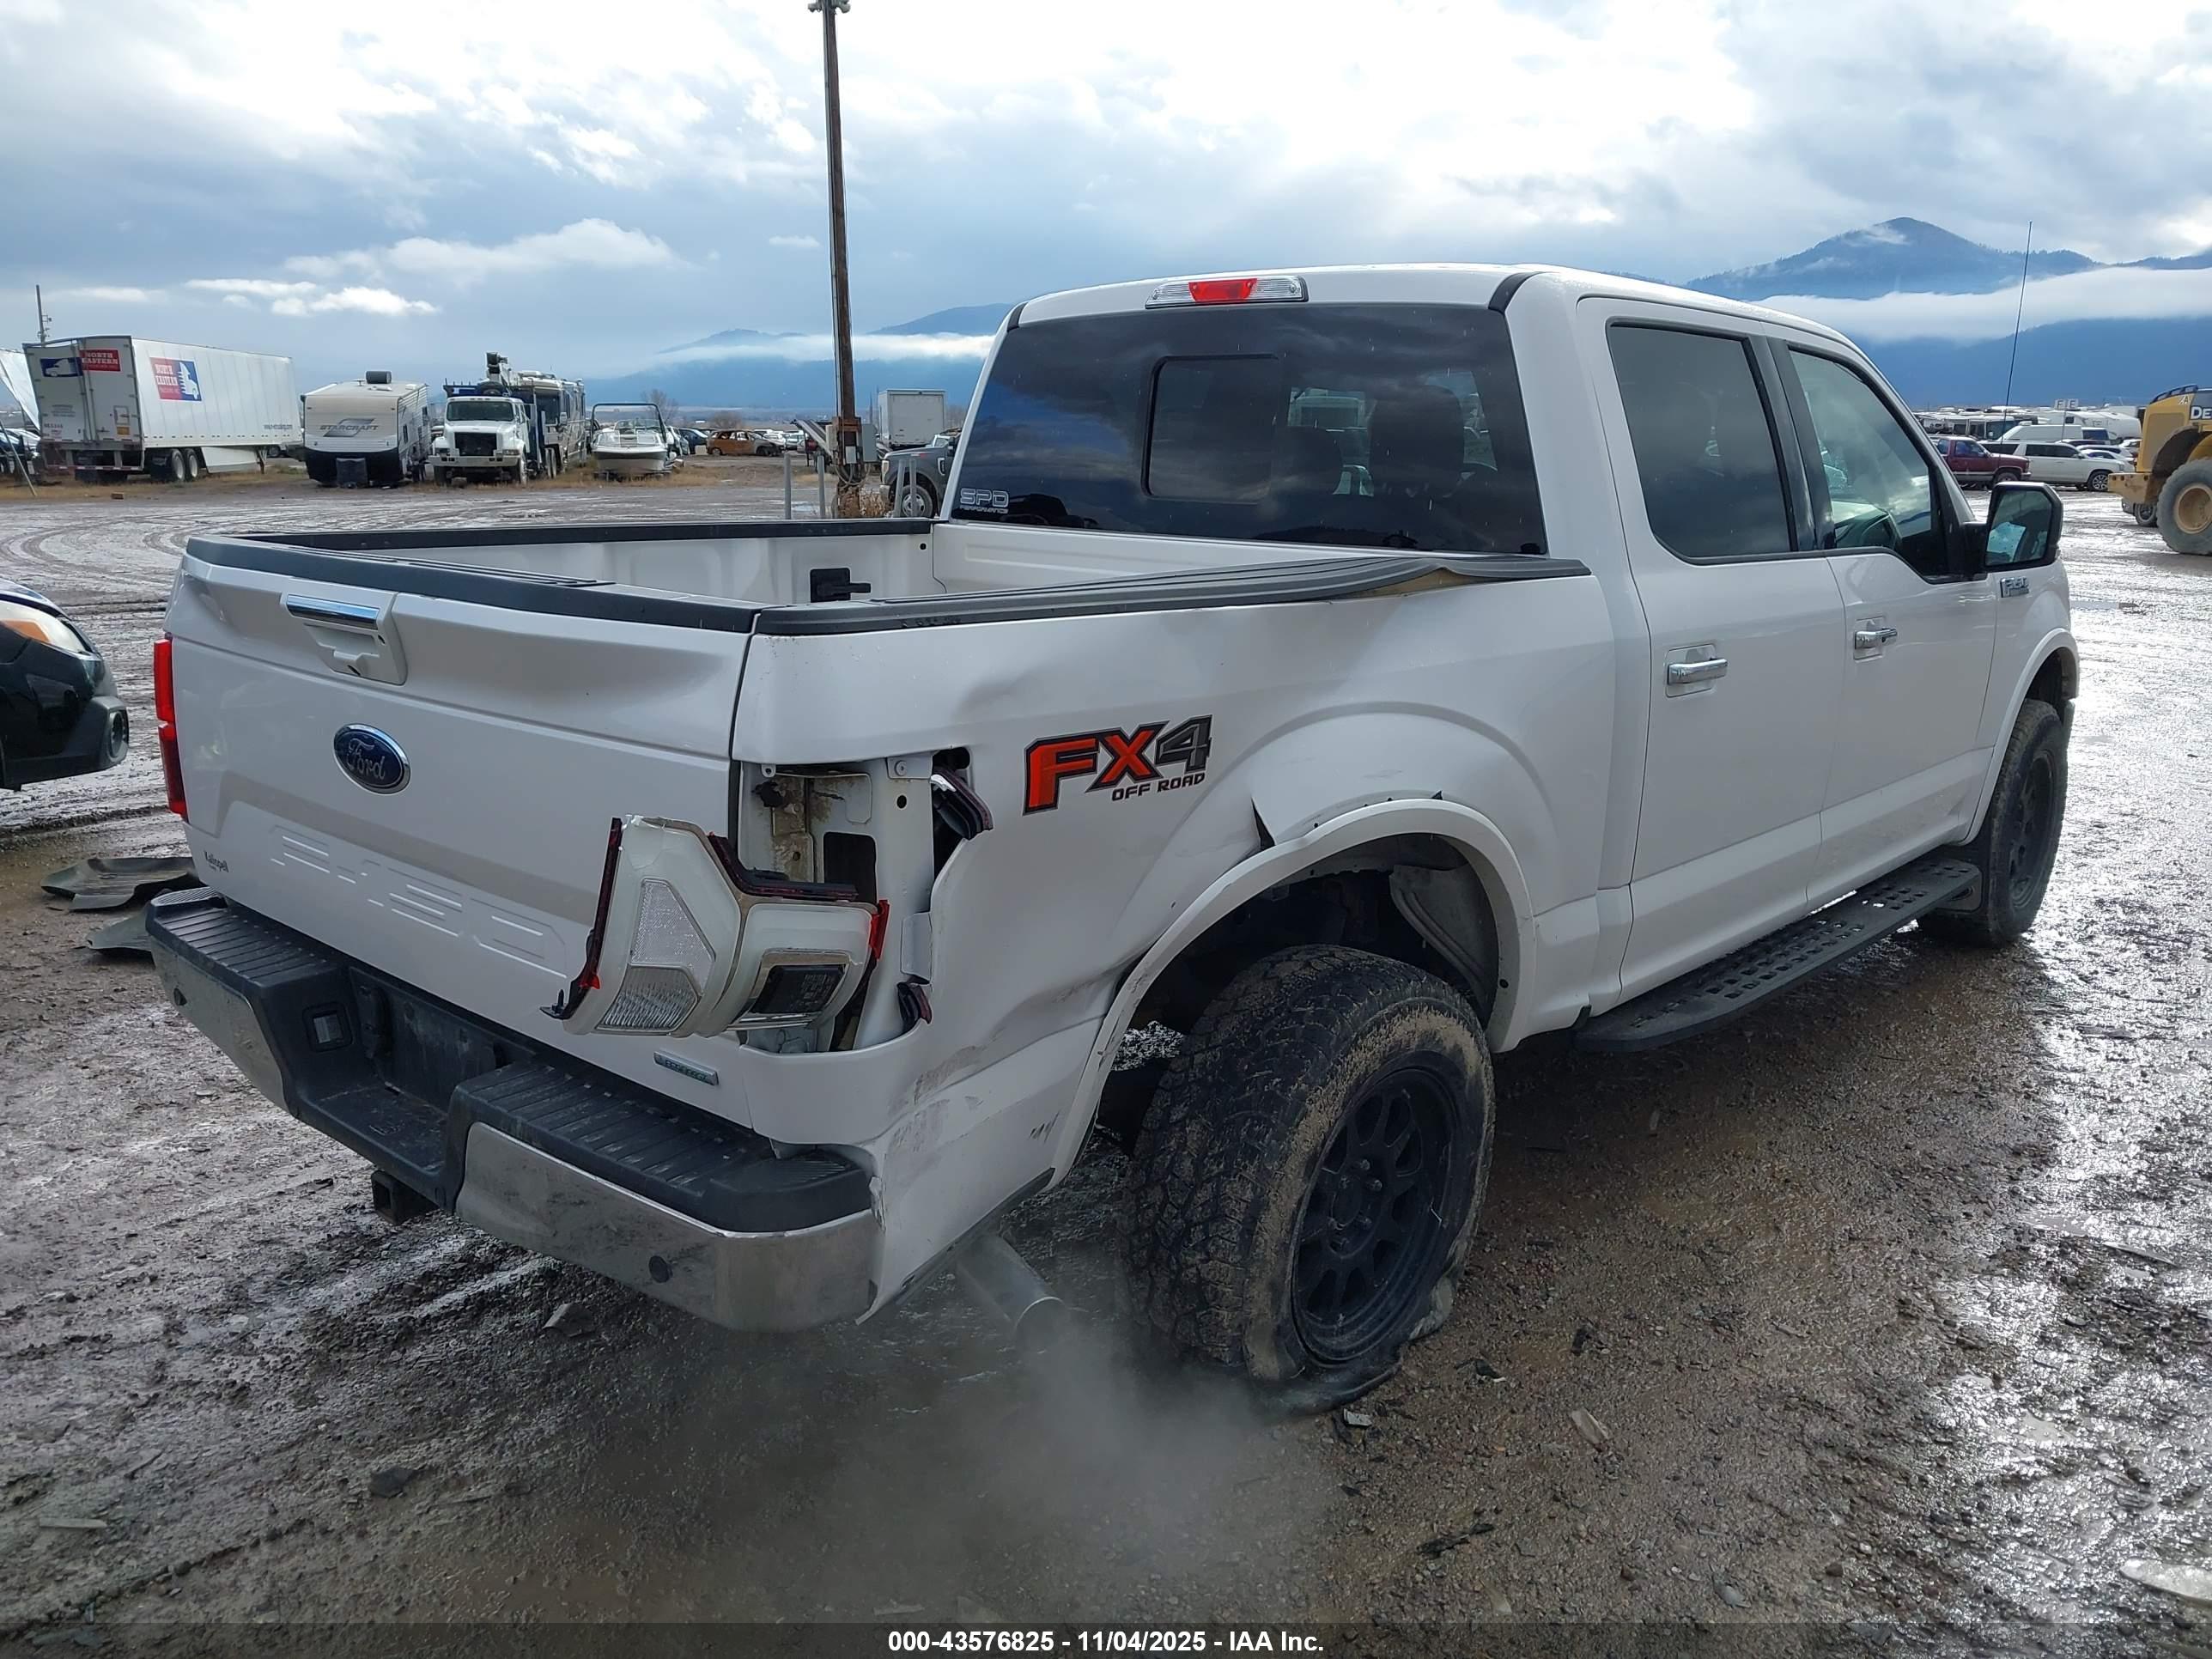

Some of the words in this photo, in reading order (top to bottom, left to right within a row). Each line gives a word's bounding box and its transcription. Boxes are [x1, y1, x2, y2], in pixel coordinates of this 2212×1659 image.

[155, 364, 173, 374] NORTH
[155, 375, 179, 386] EASTERN
[960, 488, 1009, 507] SPD
[346, 738, 386, 780] Ford
[1022, 714, 1212, 816] FX4
[1111, 782, 1151, 802] OFF
[1157, 773, 1206, 793] ROAD
